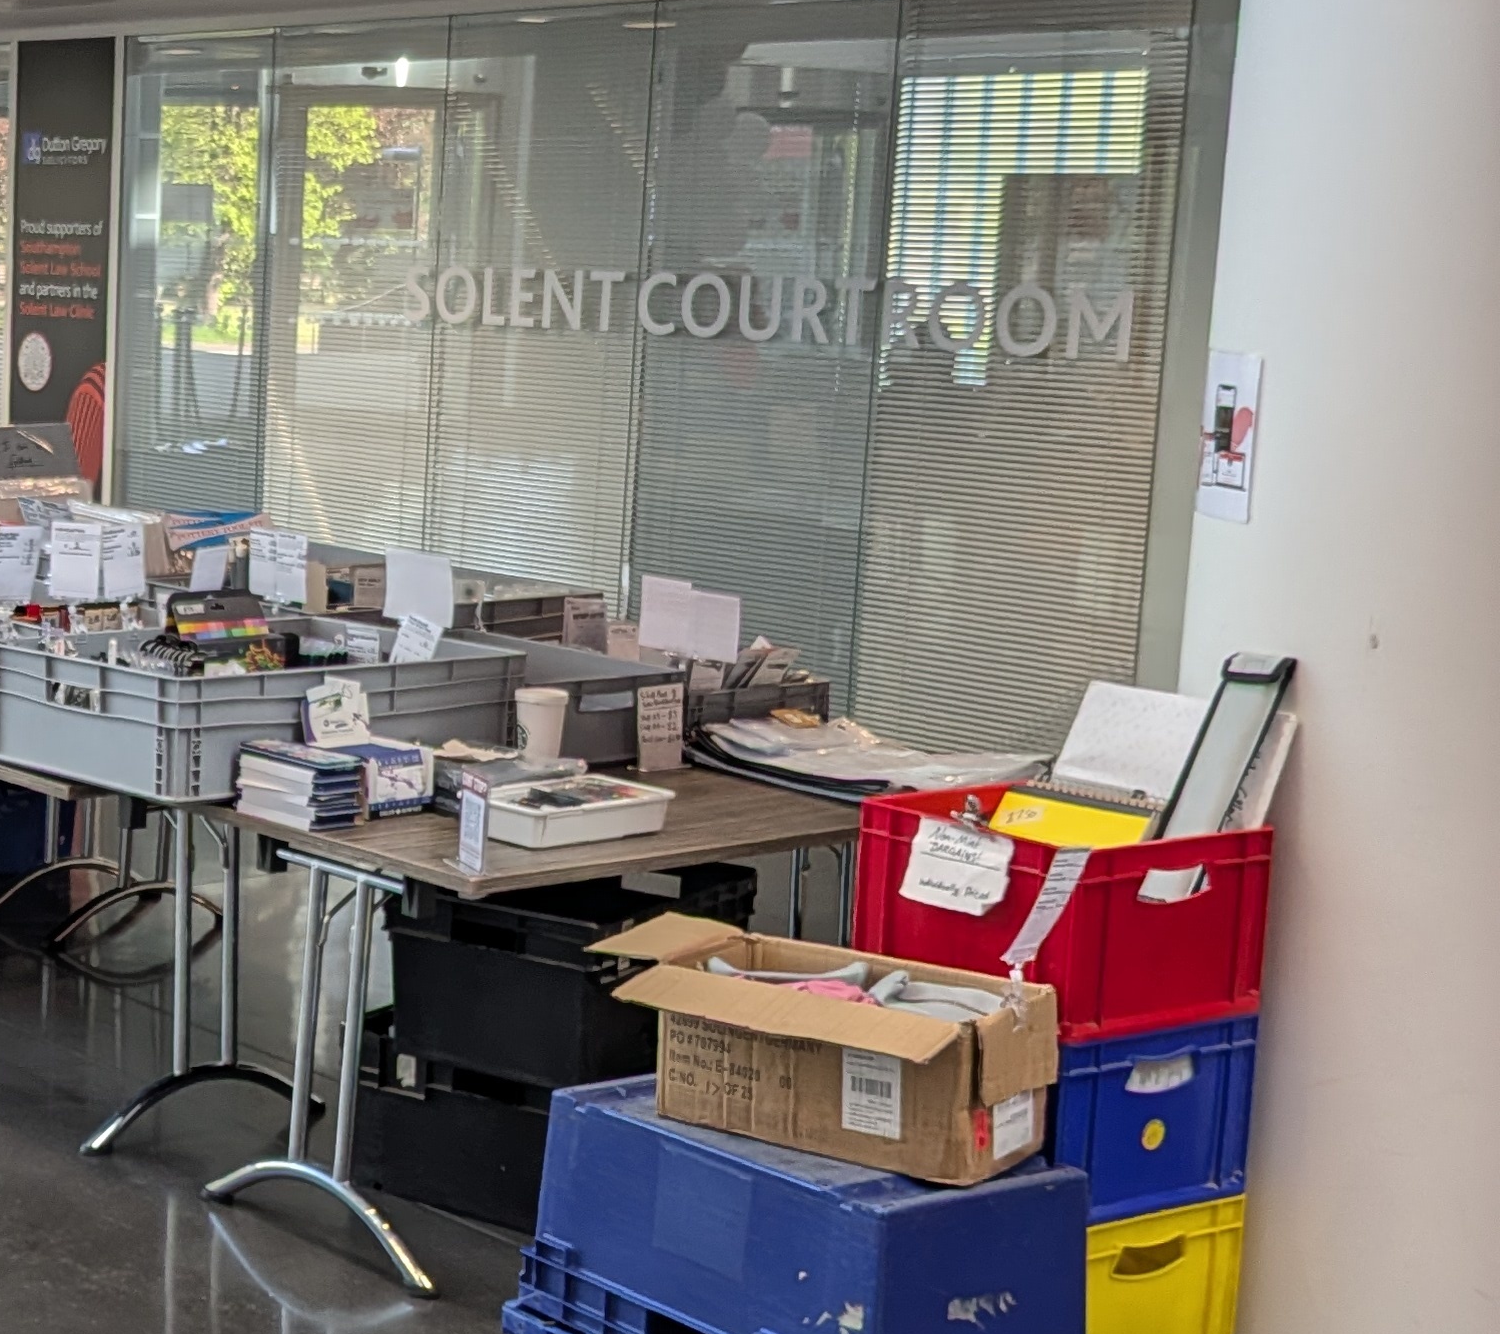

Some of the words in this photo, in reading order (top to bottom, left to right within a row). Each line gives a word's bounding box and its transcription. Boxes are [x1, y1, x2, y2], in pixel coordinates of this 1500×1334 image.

[41, 135, 70, 152] Dutton
[71, 135, 108, 155] Gregory
[20, 218, 46, 234] Proud
[46, 221, 92, 239] supporters
[92, 220, 104, 236] of
[19, 280, 36, 296] and
[36, 282, 71, 300] partners
[72, 283, 81, 299] in
[82, 282, 98, 299] the
[404, 266, 626, 331] SOLENT
